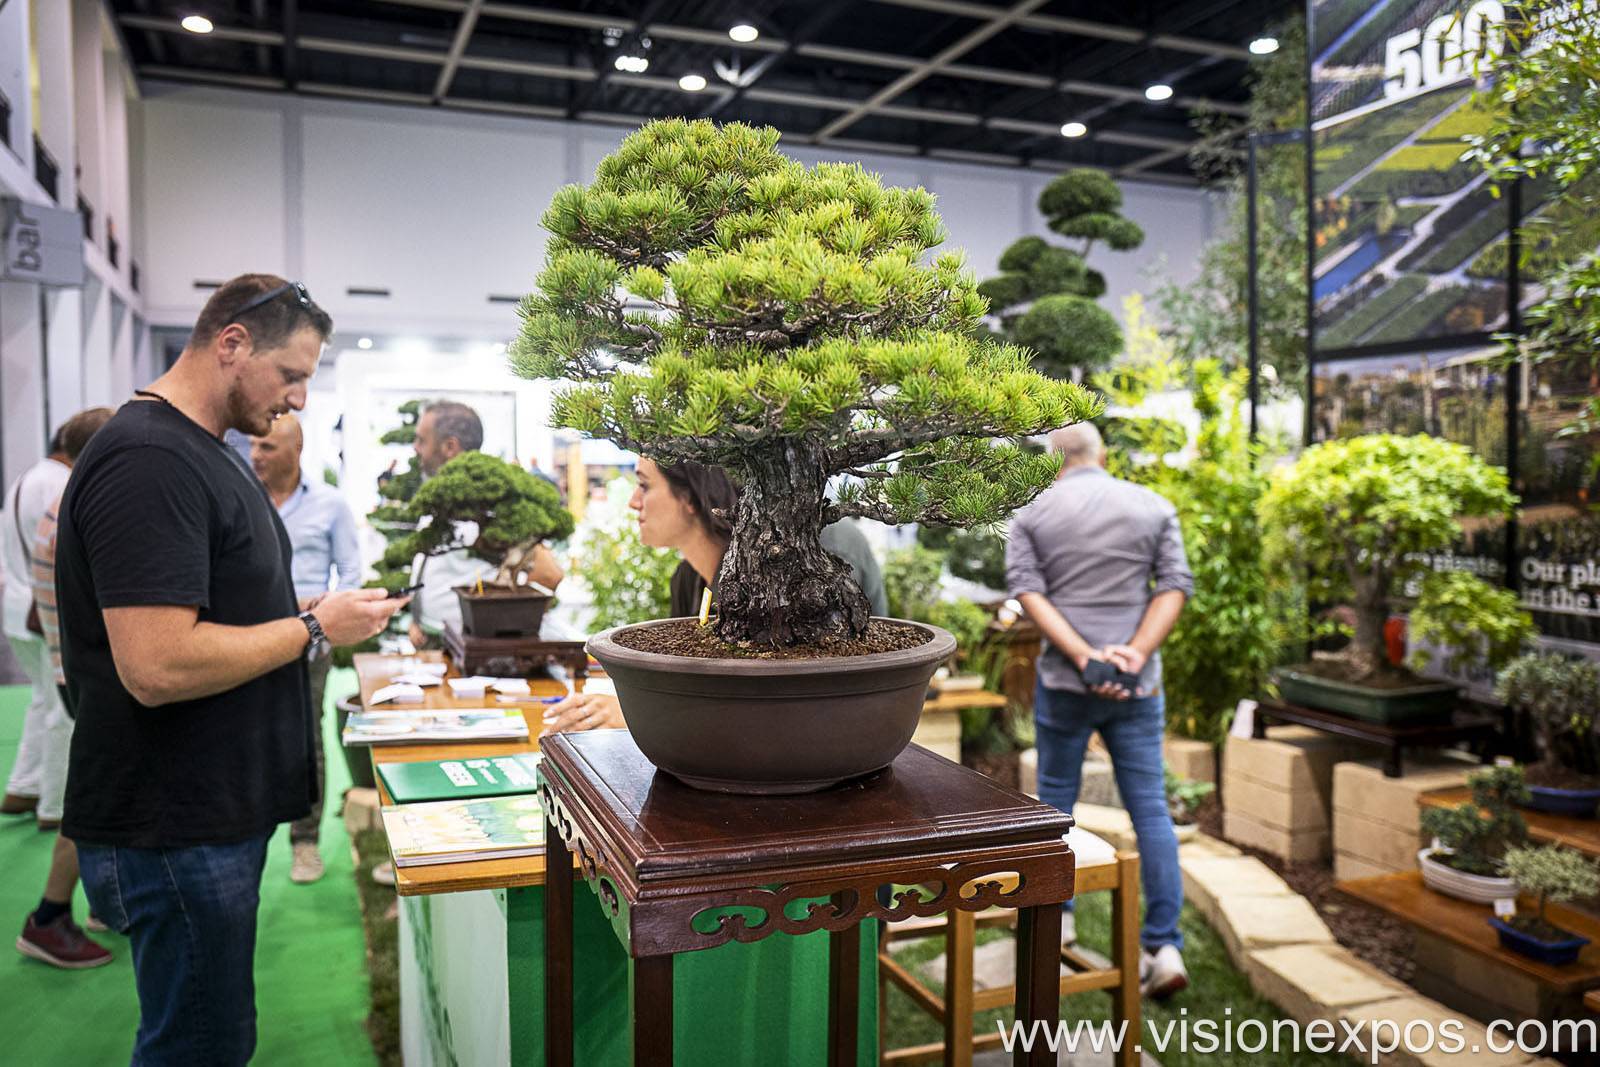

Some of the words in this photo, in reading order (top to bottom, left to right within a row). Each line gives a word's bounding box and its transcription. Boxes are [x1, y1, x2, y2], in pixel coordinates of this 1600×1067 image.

[13, 208, 42, 272] bar
[1521, 556, 1567, 582] Our
[1549, 586, 1591, 611] the
